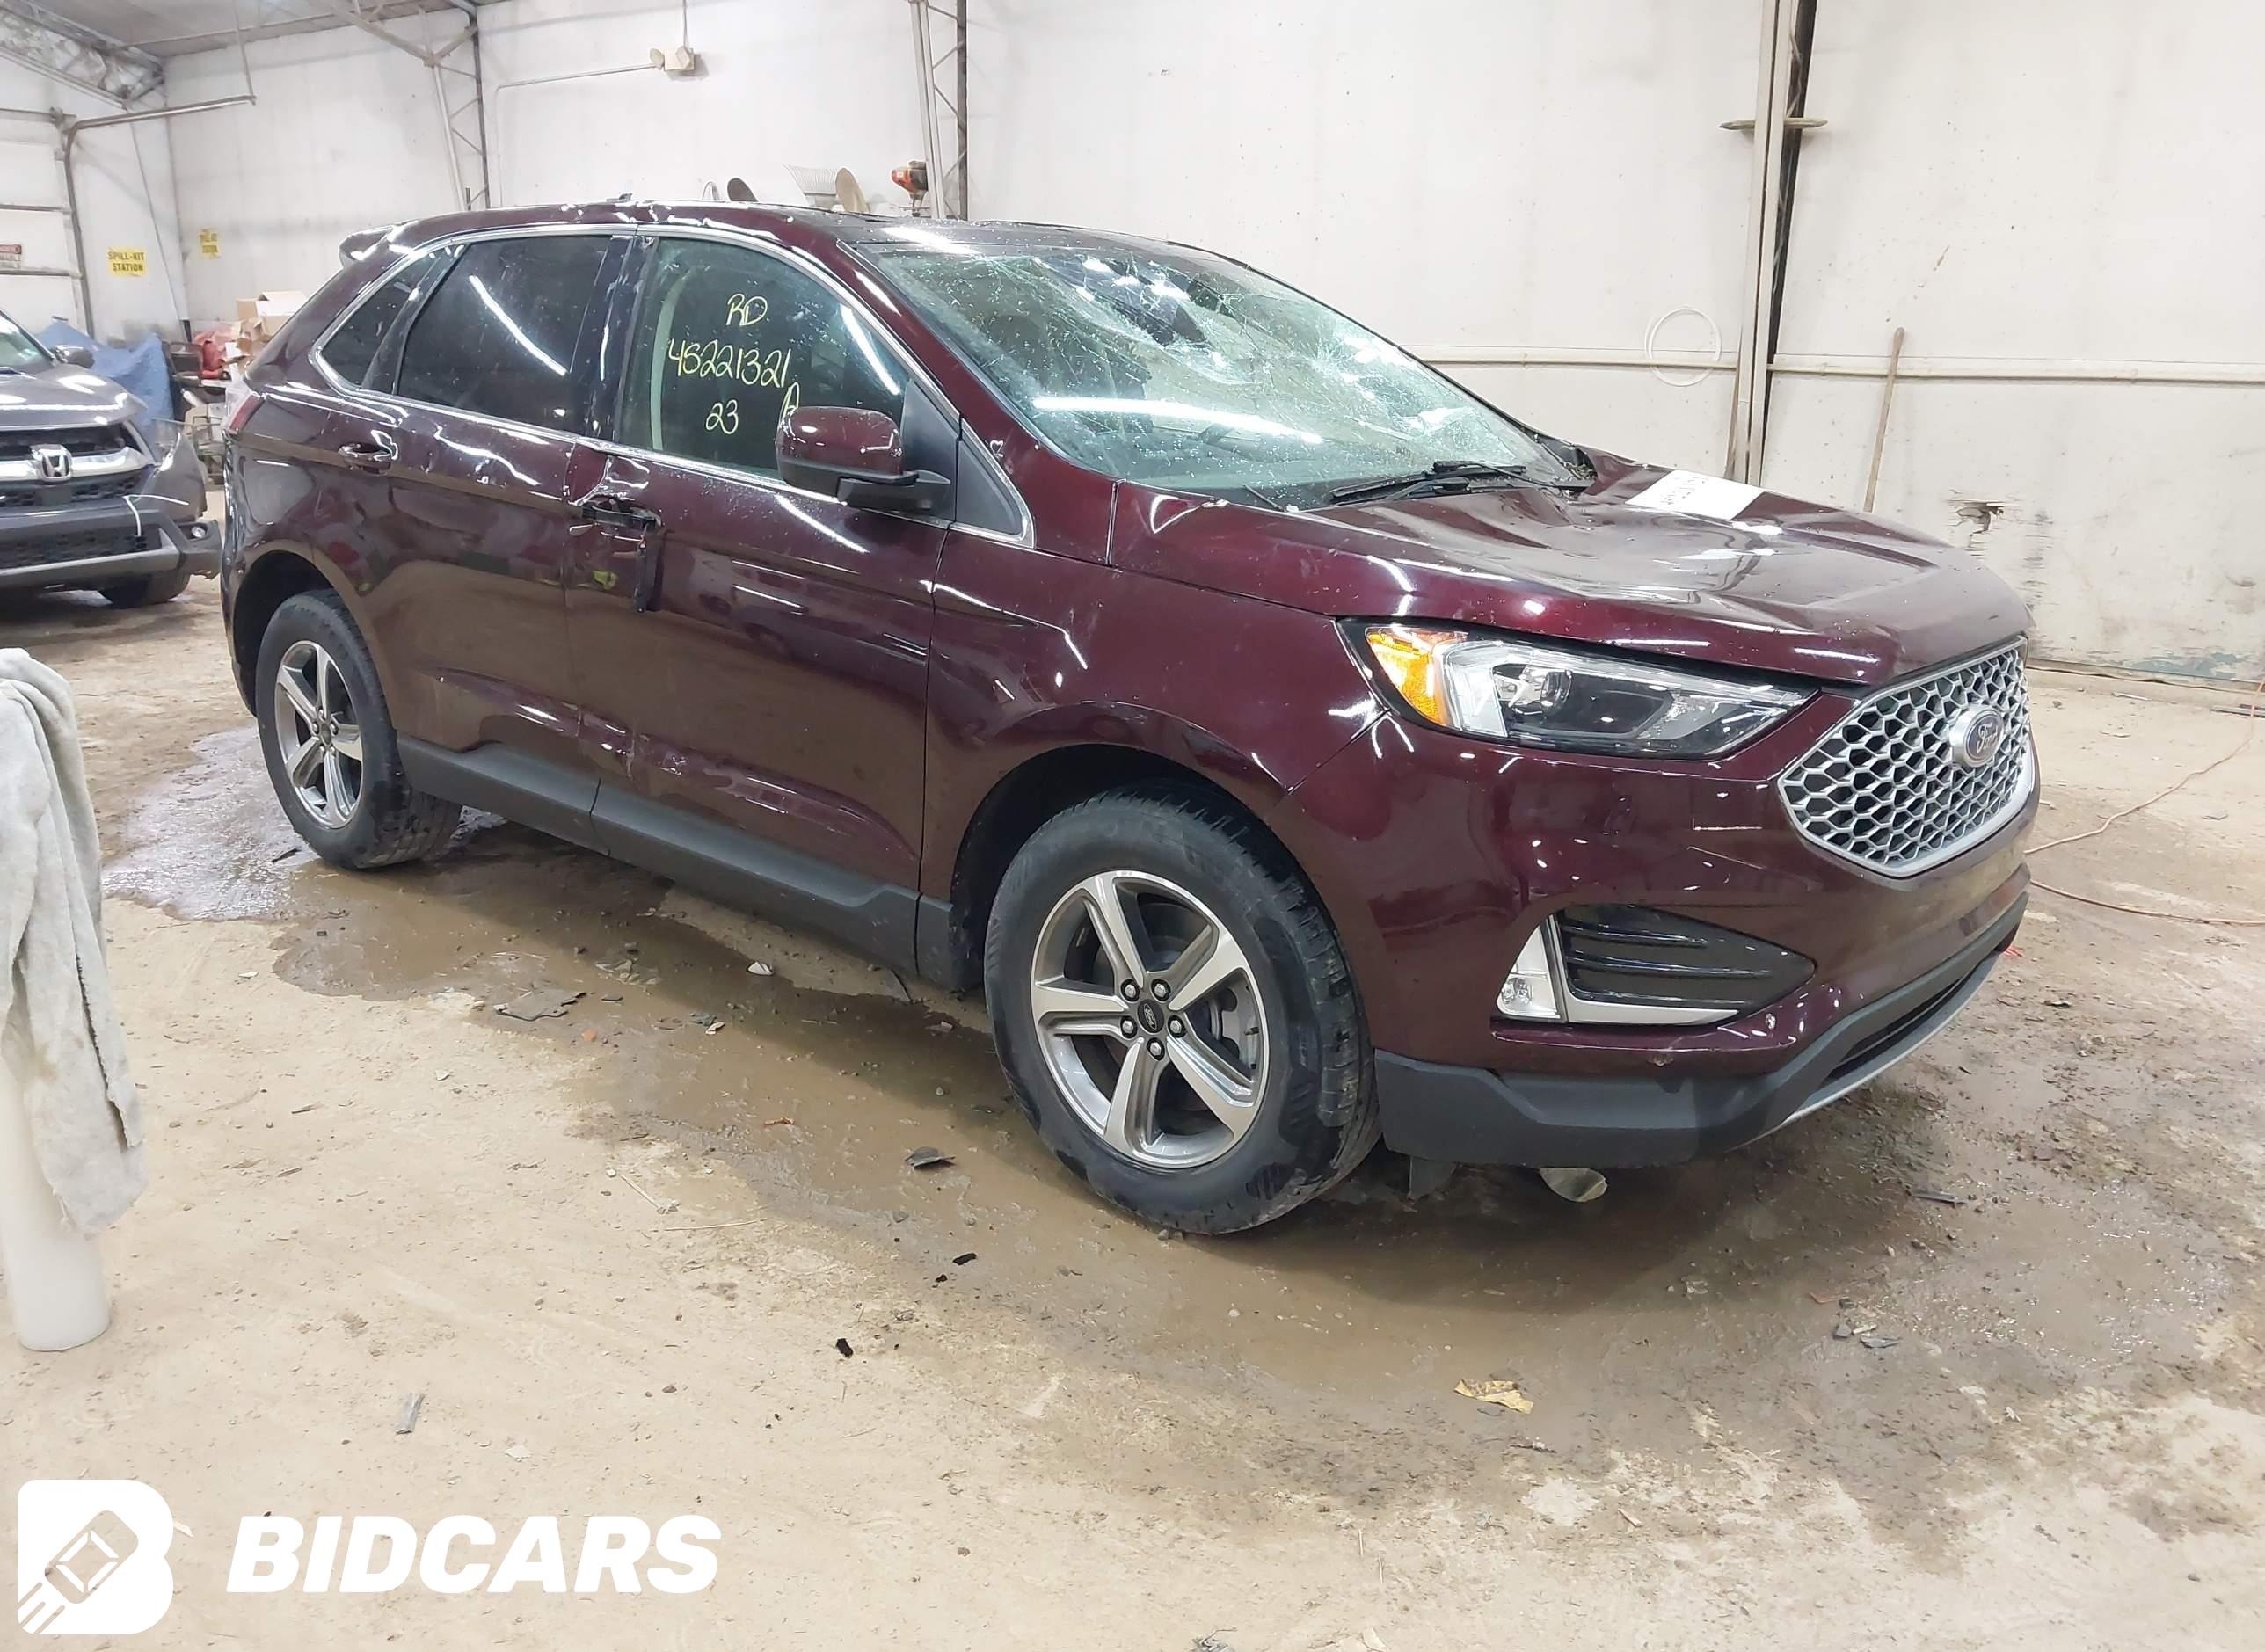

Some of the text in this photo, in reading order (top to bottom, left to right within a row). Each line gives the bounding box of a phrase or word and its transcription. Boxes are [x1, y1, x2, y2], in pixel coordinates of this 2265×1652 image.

[108, 251, 144, 261] SPILL-KIT
[112, 262, 143, 272] STATION
[705, 399, 739, 434] 23
[1976, 722, 1999, 753] Ford
